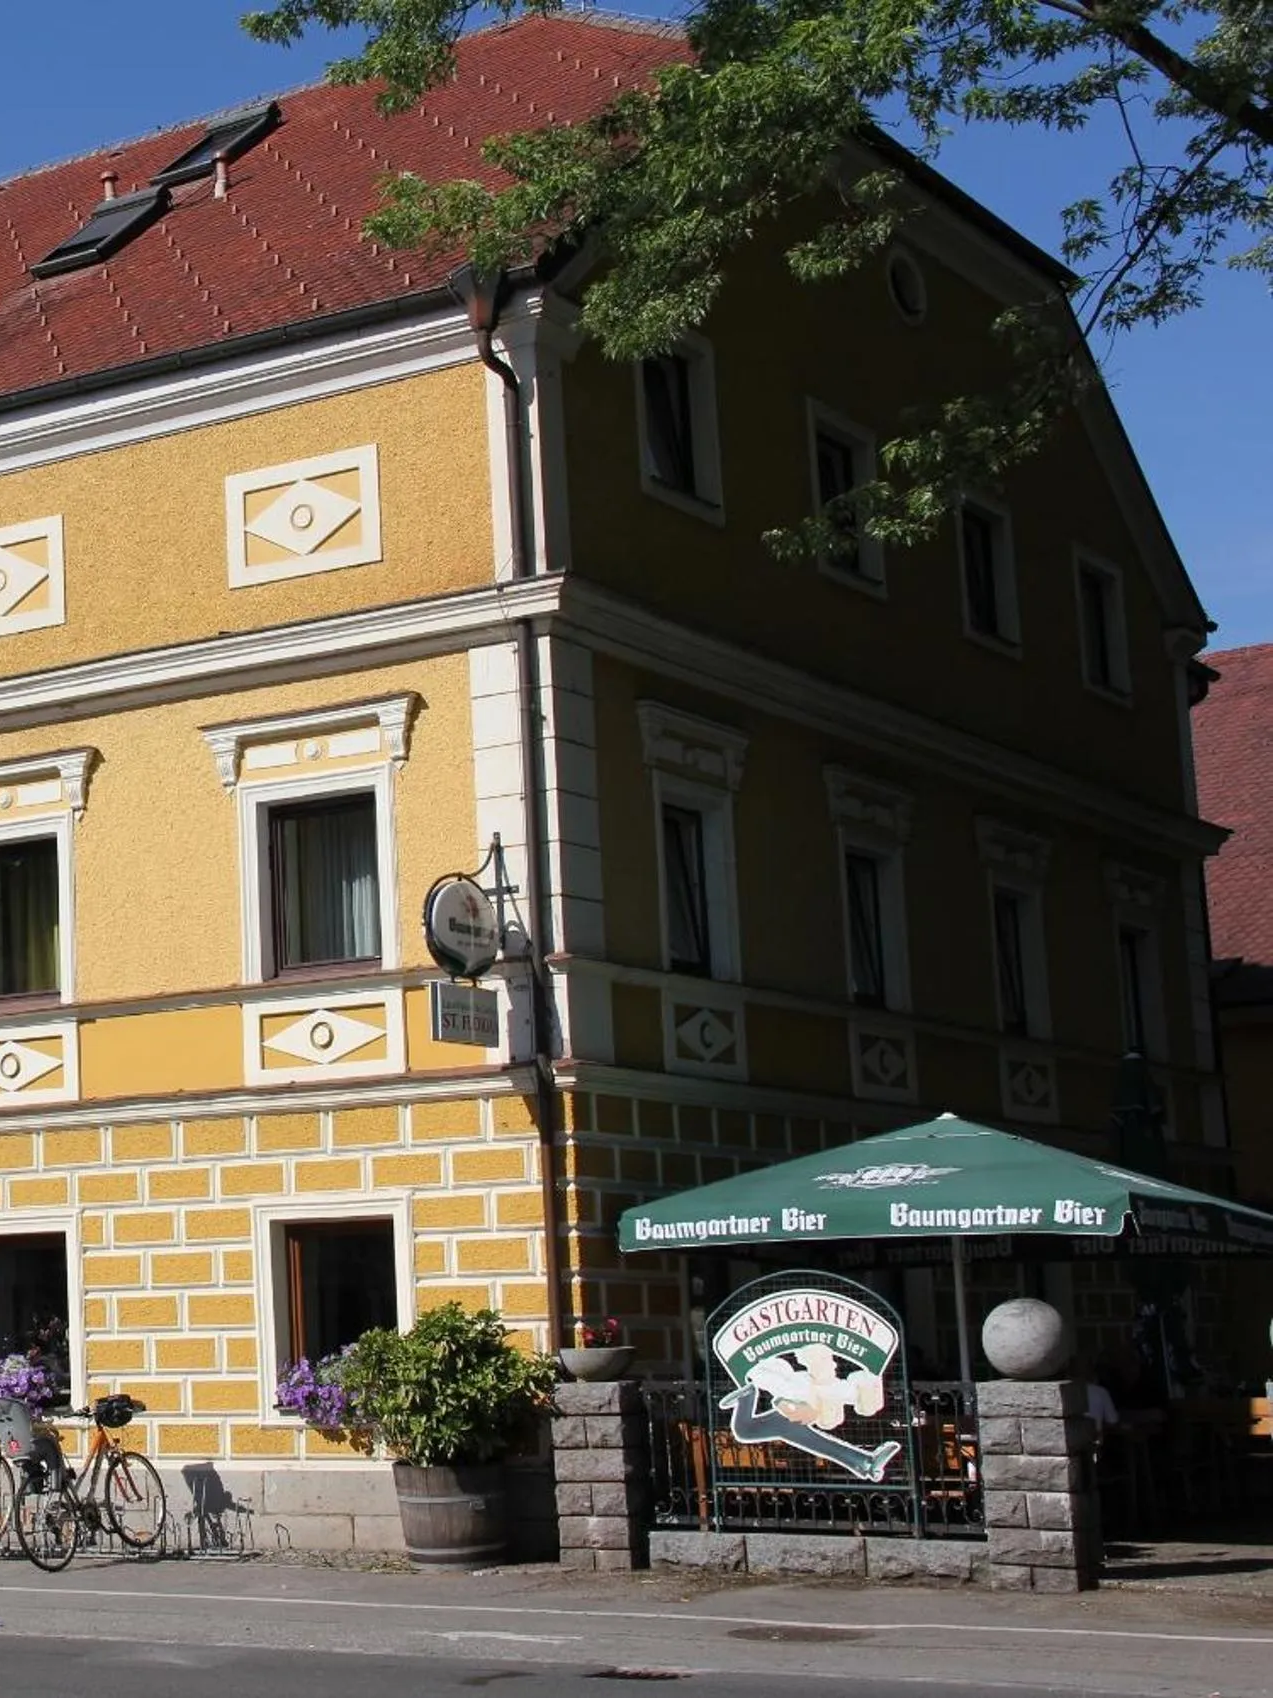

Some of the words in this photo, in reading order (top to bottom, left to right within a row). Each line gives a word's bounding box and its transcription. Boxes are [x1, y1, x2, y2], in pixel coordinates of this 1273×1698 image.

[635, 1217, 770, 1240] Baumgartner
[782, 1207, 826, 1231] Bier
[890, 1202, 1042, 1228] Baumgartner
[1053, 1199, 1106, 1225] Bier
[733, 1297, 877, 1343] GASTGARTEN
[742, 1328, 834, 1363] Baumgartner
[836, 1332, 868, 1357] Bier
